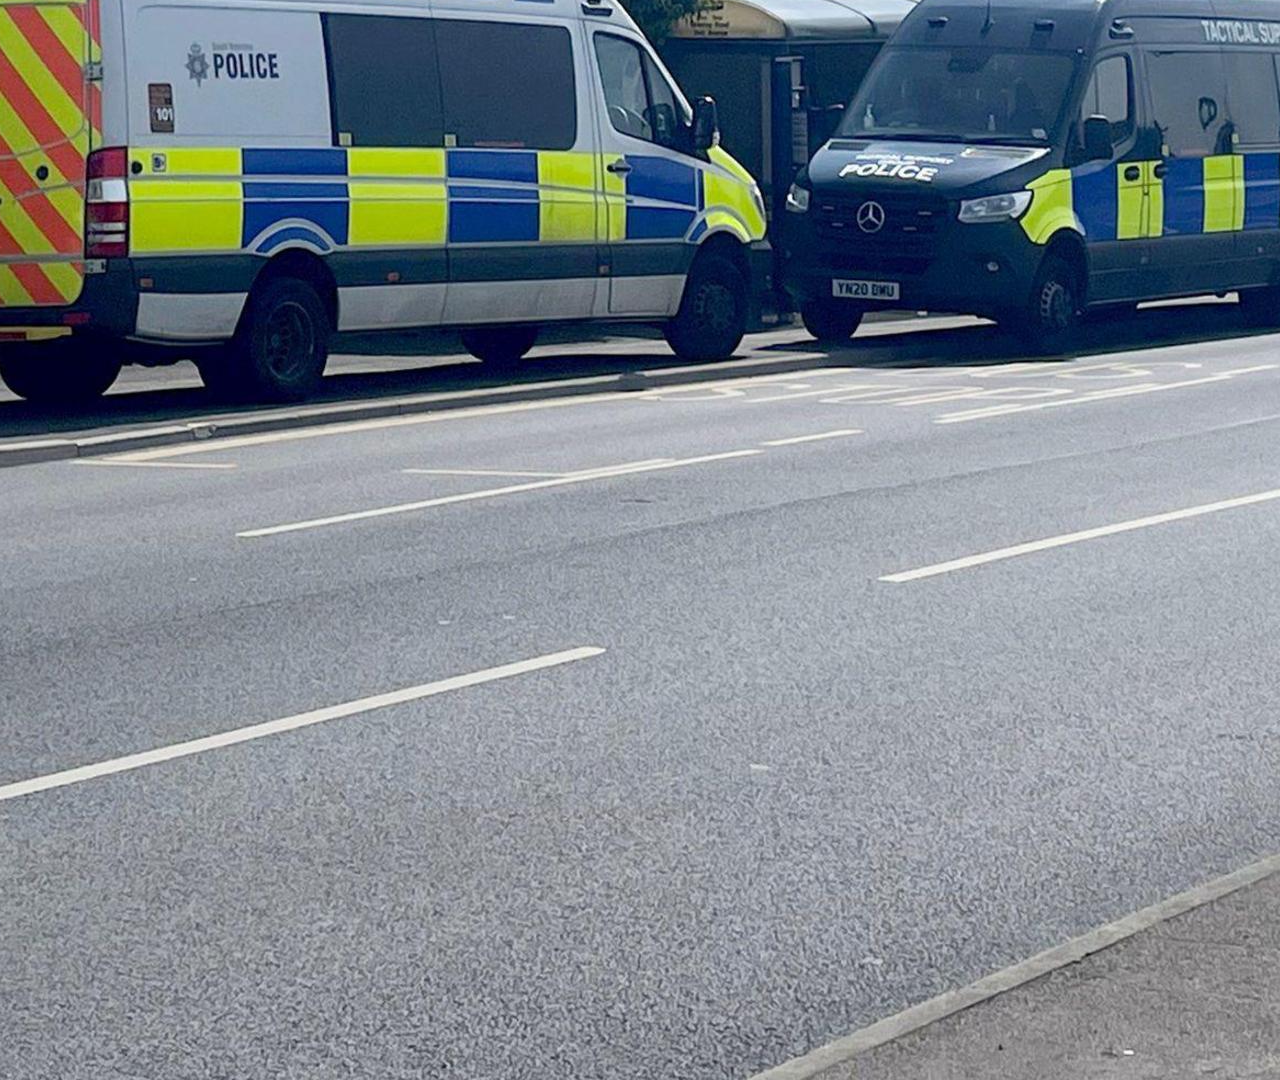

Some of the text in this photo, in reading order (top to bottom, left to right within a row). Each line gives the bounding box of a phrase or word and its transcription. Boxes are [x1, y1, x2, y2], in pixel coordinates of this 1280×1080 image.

[1201, 21, 1258, 42] TACTICAL
[213, 53, 279, 79] POLICE
[157, 107, 173, 121] 101
[839, 162, 939, 181] POLICE
